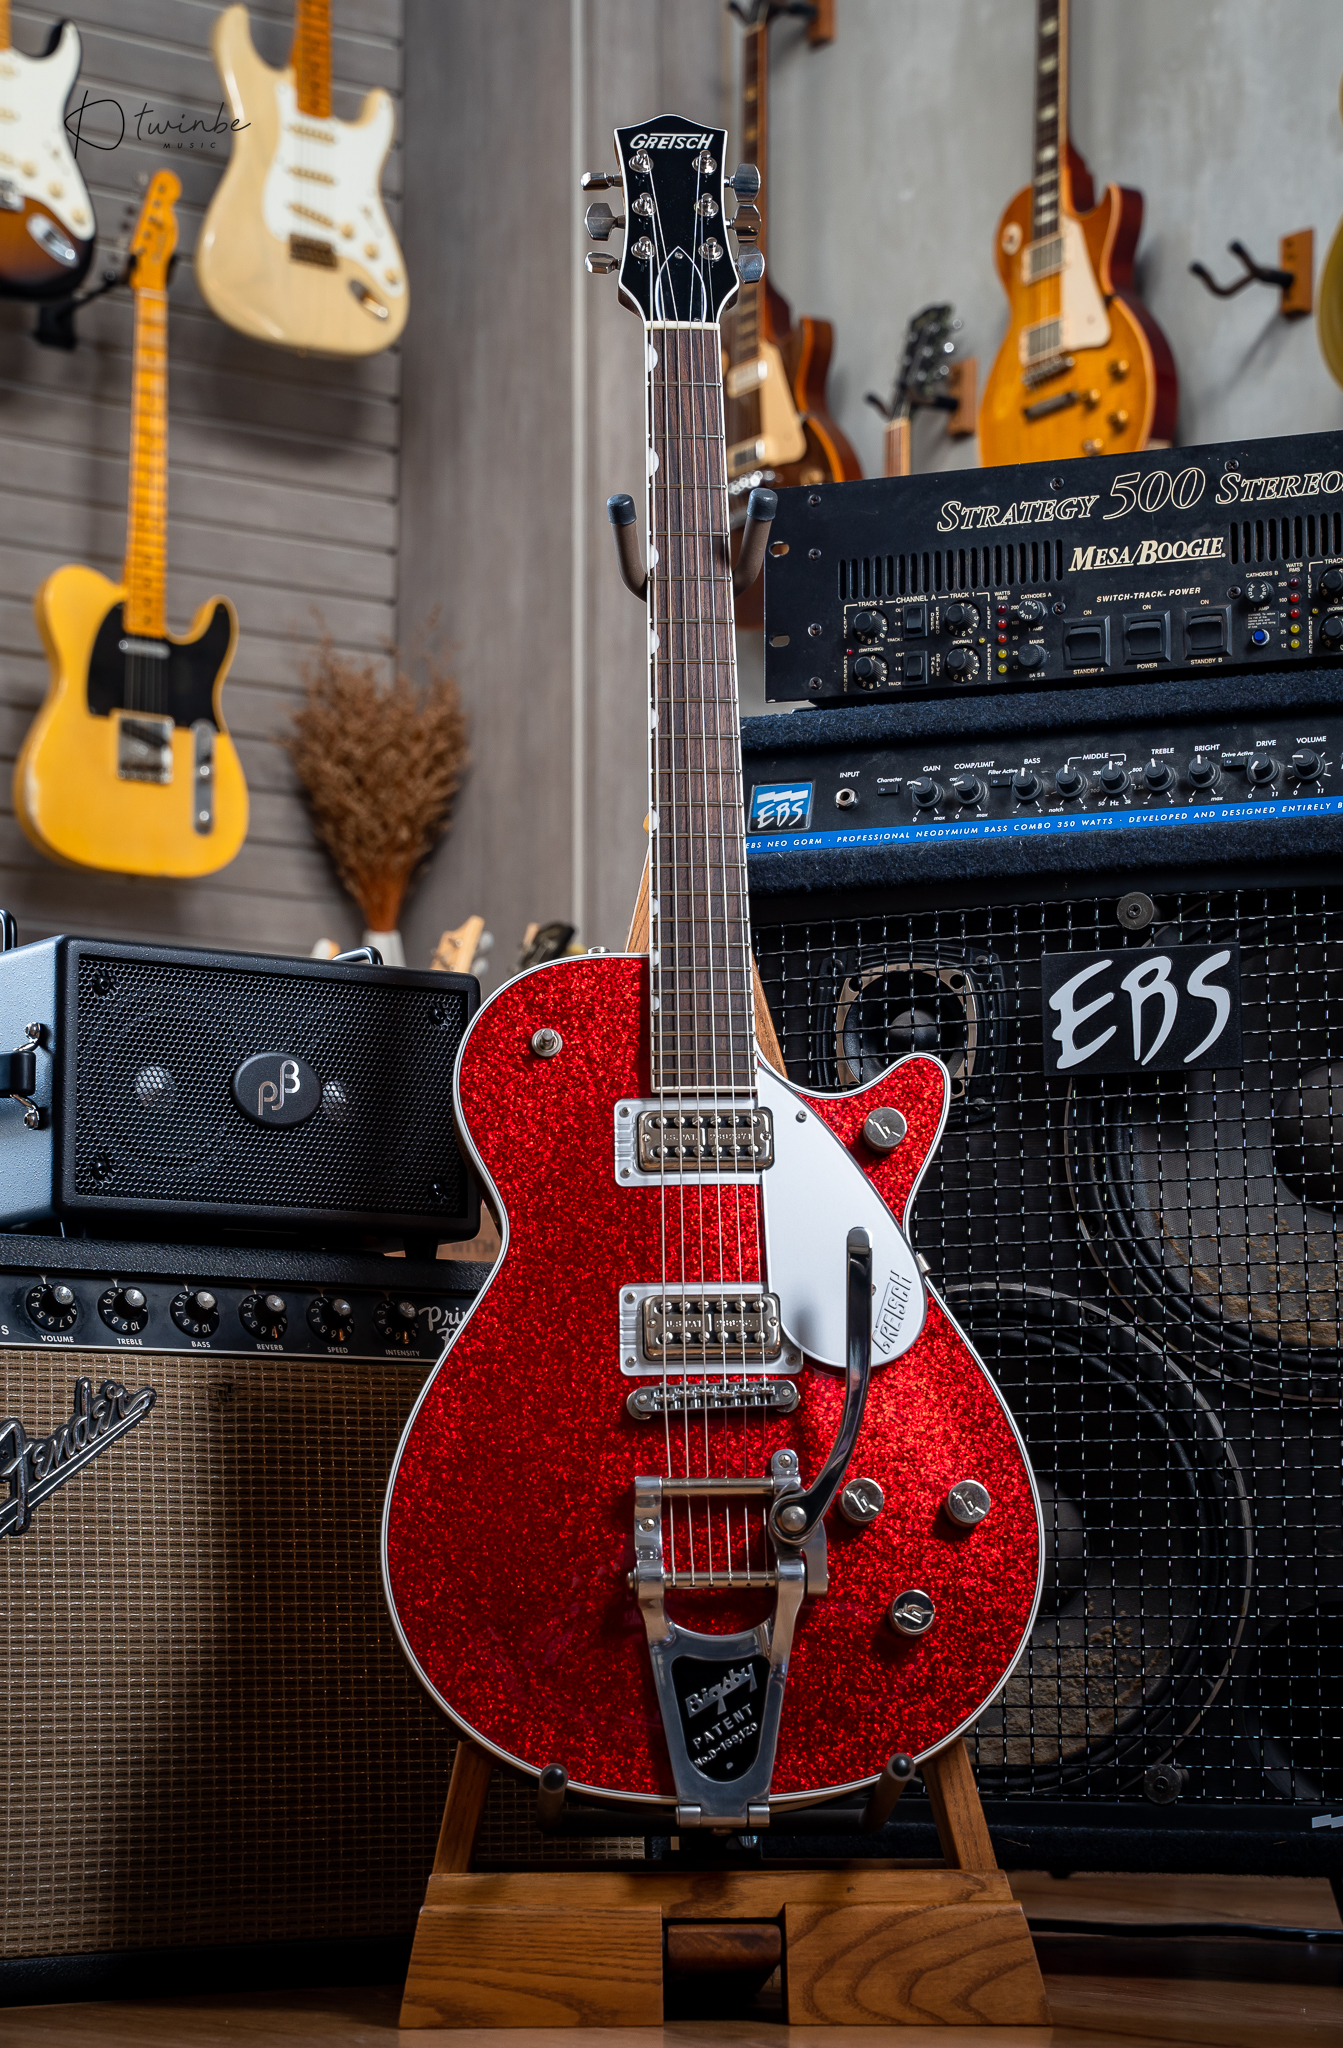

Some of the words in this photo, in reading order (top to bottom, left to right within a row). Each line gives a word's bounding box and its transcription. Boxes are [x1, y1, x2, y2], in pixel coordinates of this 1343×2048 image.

[629, 133, 714, 149] GRETSCH
[937, 494, 1100, 532] STRATEGY
[1102, 467, 1206, 520] 500
[1068, 537, 1225, 571] MESA/BOOGIE
[1169, 587, 1201, 596] POWER
[896, 595, 928, 604] CHANNEL
[1296, 735, 1327, 743] VOLUME
[1082, 752, 1109, 760] MIDDLE
[1151, 747, 1174, 755] TREBLE
[953, 761, 994, 770] COMP/LIMIT
[757, 801, 804, 829] EBS
[767, 840, 787, 848] NEO
[793, 838, 822, 846] GORM
[836, 832, 910, 843] PROFESSIONAL
[916, 827, 978, 838] NEODYMIUM
[984, 825, 1008, 833] BASS
[1013, 822, 1051, 831] COMBO
[1057, 820, 1075, 828] 350
[1081, 818, 1113, 826] WATTS
[1128, 813, 1188, 823] DEVELOPED
[1222, 807, 1276, 817] DESIGNED
[1281, 803, 1331, 812] ENTIRELY
[1049, 950, 1232, 1070] EBS
[37, 1311, 46, 1319] 5
[48, 1317, 55, 1325] 6
[59, 1319, 65, 1328] 7
[66, 1315, 73, 1323] 8
[871, 1269, 912, 1355] GRETSCH
[111, 1316, 119, 1324] 8
[121, 1322, 128, 1330] 9
[130, 1321, 140, 1331] 10
[182, 1318, 190, 1326] 8
[193, 1324, 199, 1332] 9
[40, 1335, 74, 1343] VOLUME
[117, 1338, 143, 1346] TREBLE
[256, 1343, 284, 1351] REVERB
[385, 1349, 420, 1357] INTENSITY
[0, 1381, 156, 1531] Fender
[685, 1662, 758, 1718] Bigsby
[692, 1703, 753, 1749] PATENT
